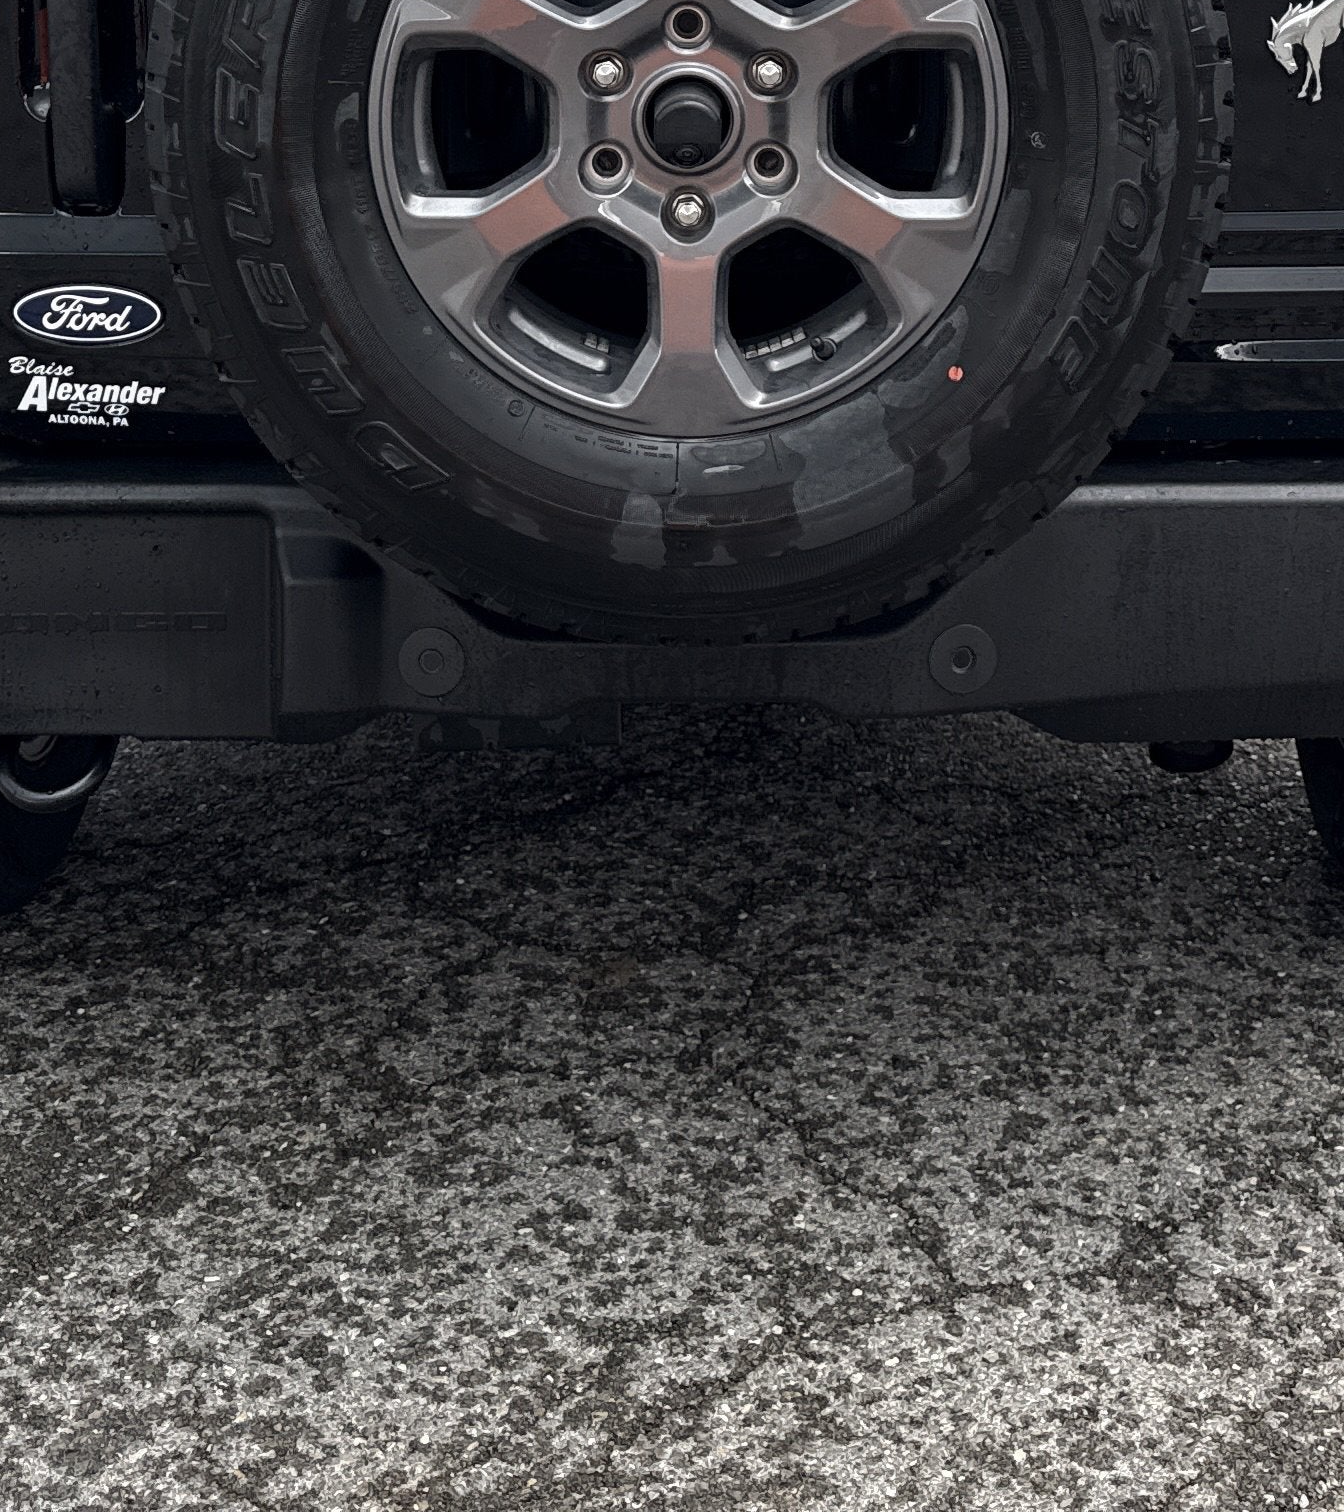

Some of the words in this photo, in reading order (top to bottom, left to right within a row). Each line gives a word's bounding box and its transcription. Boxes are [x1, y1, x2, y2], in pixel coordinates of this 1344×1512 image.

[42, 295, 133, 332] Ford
[9, 356, 75, 377] Blaise
[17, 376, 166, 412] Alexander
[48, 414, 110, 427] ALTOONA,
[112, 416, 129, 427] PA
